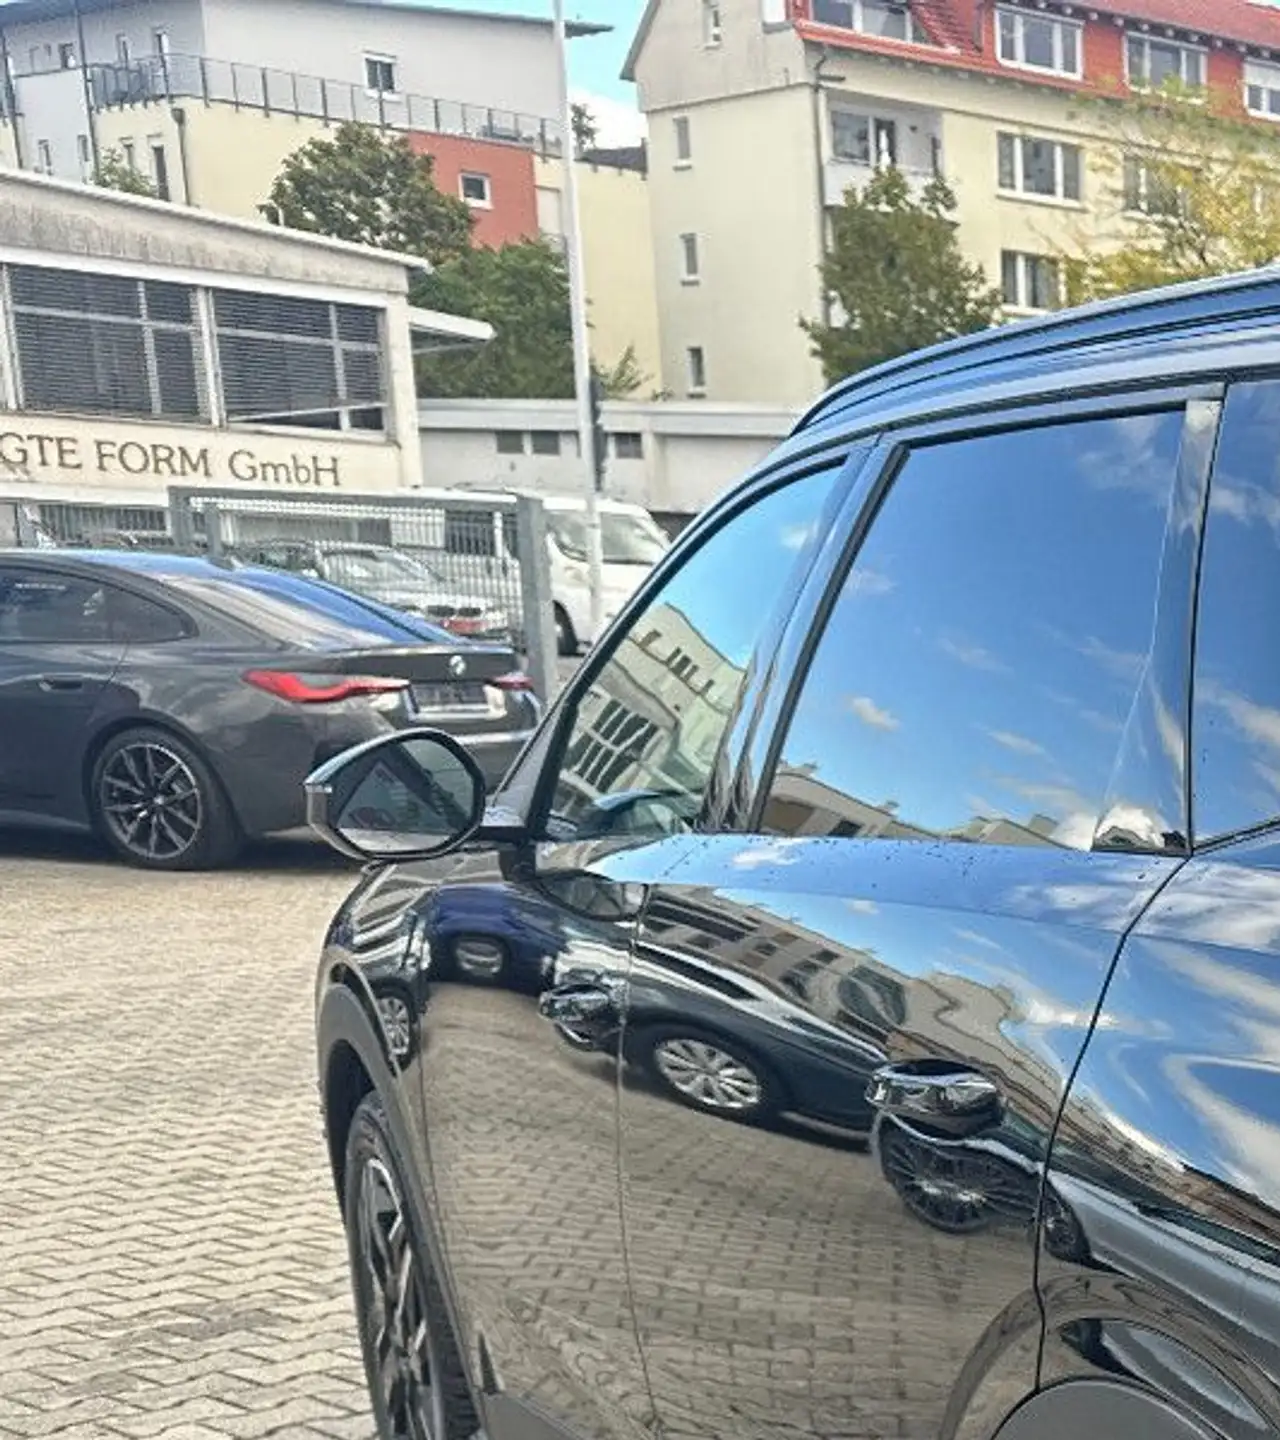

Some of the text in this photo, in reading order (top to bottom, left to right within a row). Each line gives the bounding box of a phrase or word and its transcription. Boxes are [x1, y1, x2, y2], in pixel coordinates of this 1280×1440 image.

[0, 431, 340, 487] GTE FORM GmbH
